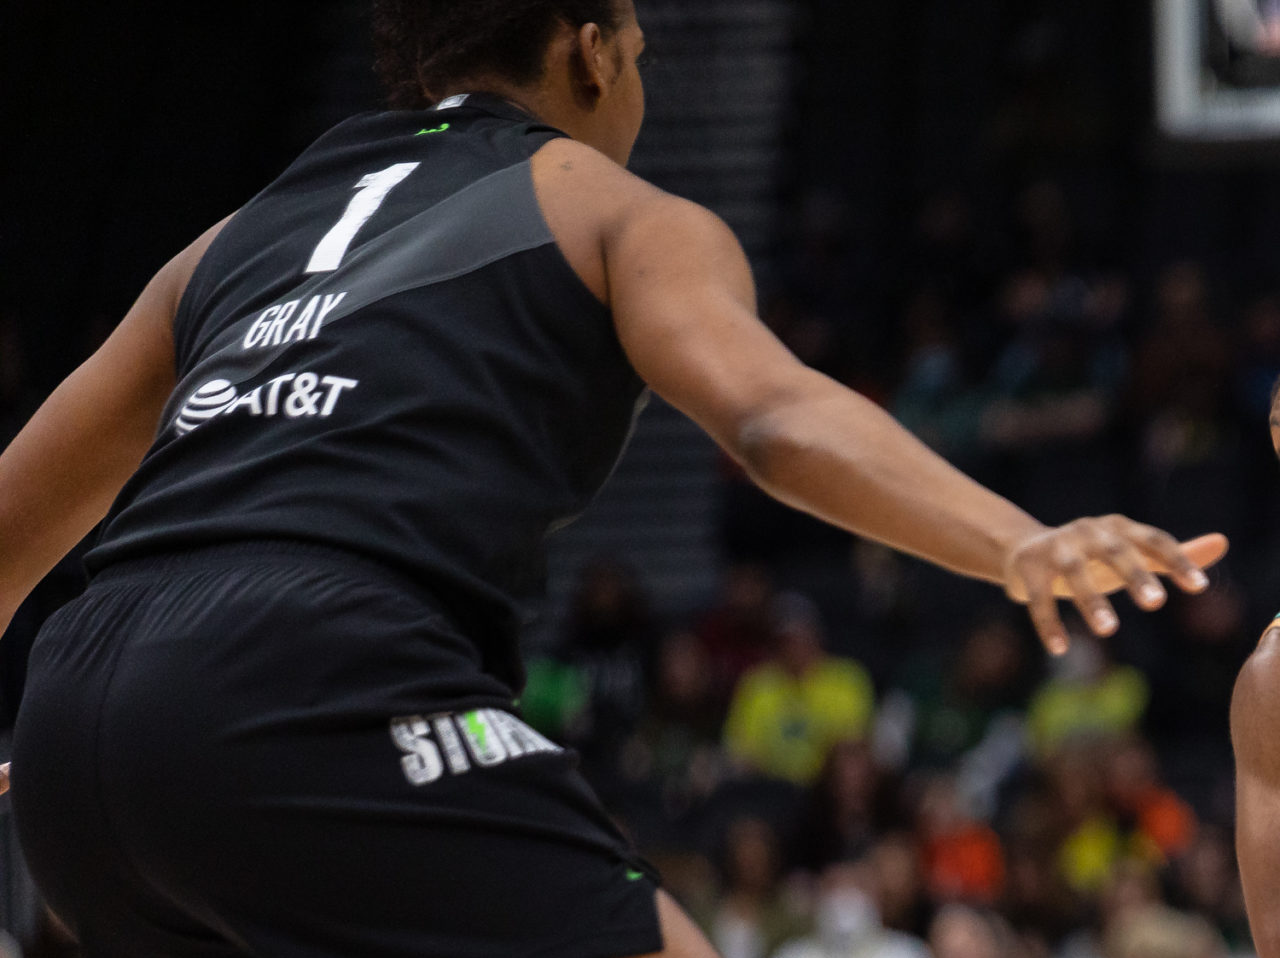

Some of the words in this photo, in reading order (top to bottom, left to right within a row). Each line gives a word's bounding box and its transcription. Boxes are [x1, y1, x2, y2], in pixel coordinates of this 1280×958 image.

[304, 161, 422, 273] 1
[243, 291, 348, 350] GRAY
[223, 371, 360, 418] AT&T
